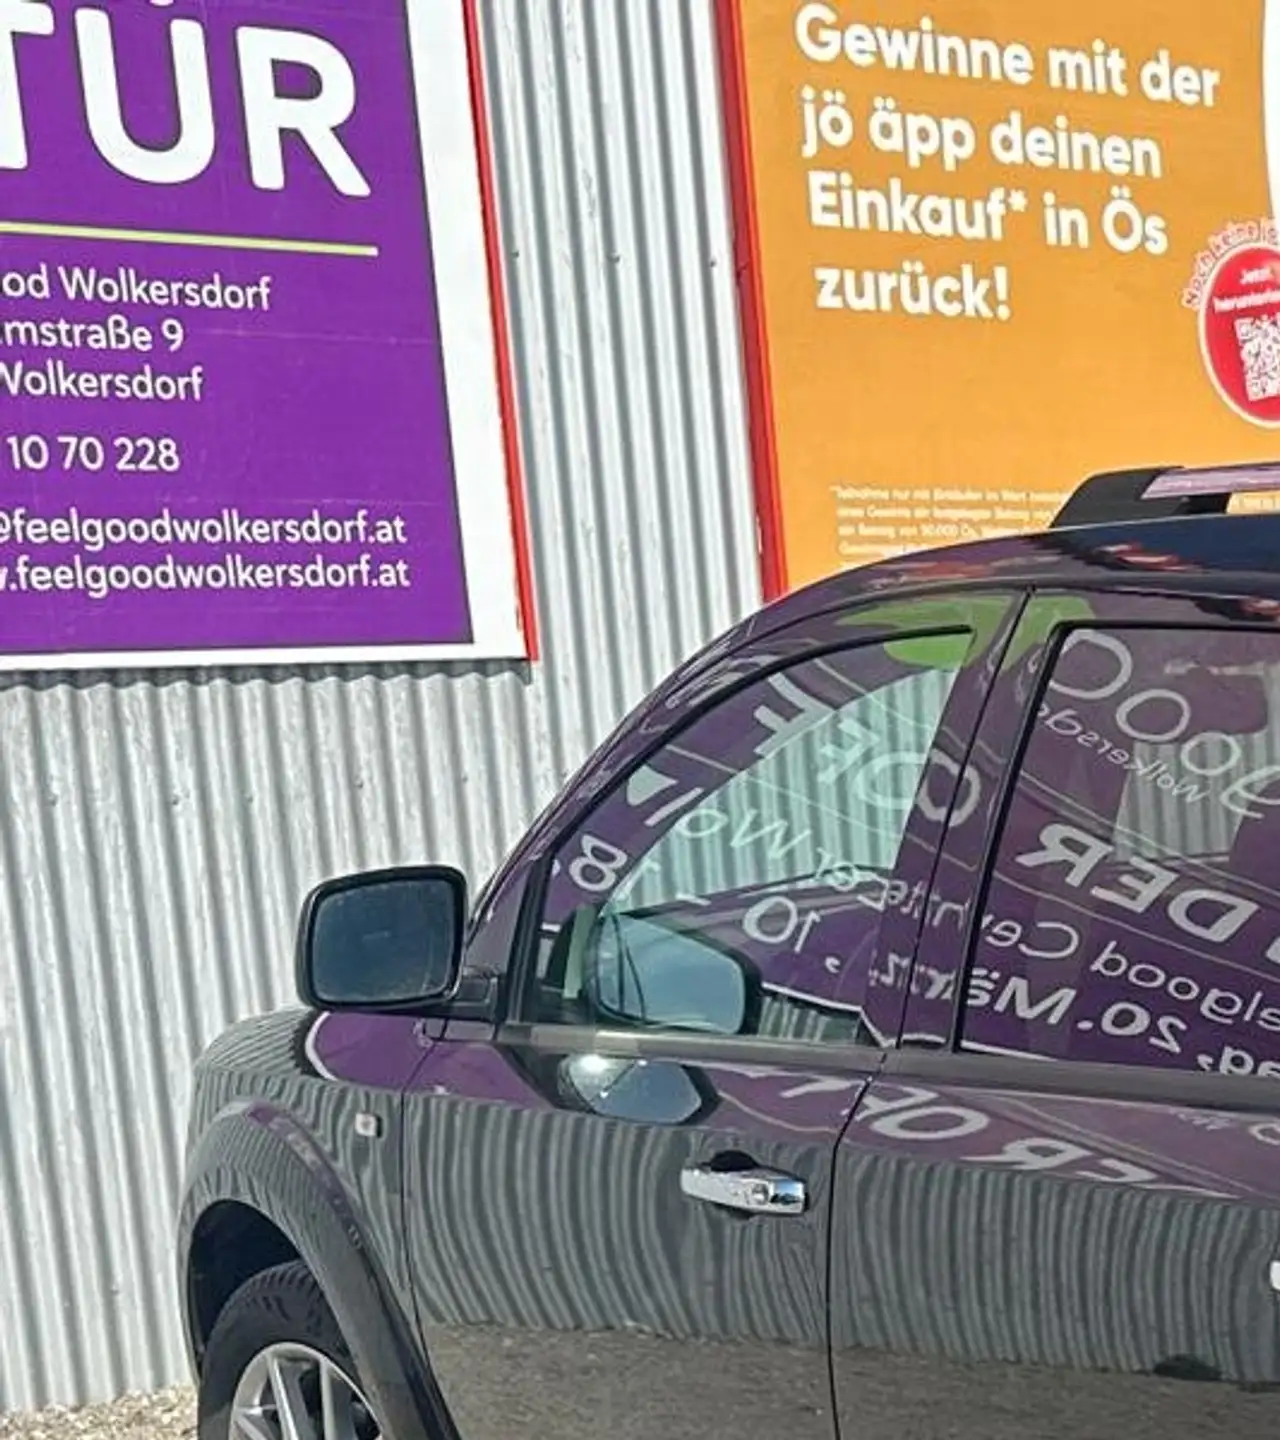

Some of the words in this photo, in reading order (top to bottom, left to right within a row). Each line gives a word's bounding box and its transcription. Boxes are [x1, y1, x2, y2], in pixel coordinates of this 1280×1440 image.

[794, 3, 1033, 85] Gewinne
[1048, 40, 1127, 95] mit
[1140, 50, 1221, 107] der
[801, 86, 854, 157] jö
[868, 96, 976, 170] äpp
[990, 111, 1162, 178] deinen
[1043, 192, 1088, 247] in
[1102, 187, 1169, 255] Ös
[57, 266, 272, 310] Wolkersdorf
[813, 263, 1012, 321] zurück!
[0, 313, 152, 352] mstraße
[161, 318, 184, 353] 9
[6, 435, 50, 471] 10
[57, 436, 106, 472] 70
[113, 437, 182, 473] 228
[0, 553, 412, 600] .feelgoodwolkersdorf.at
